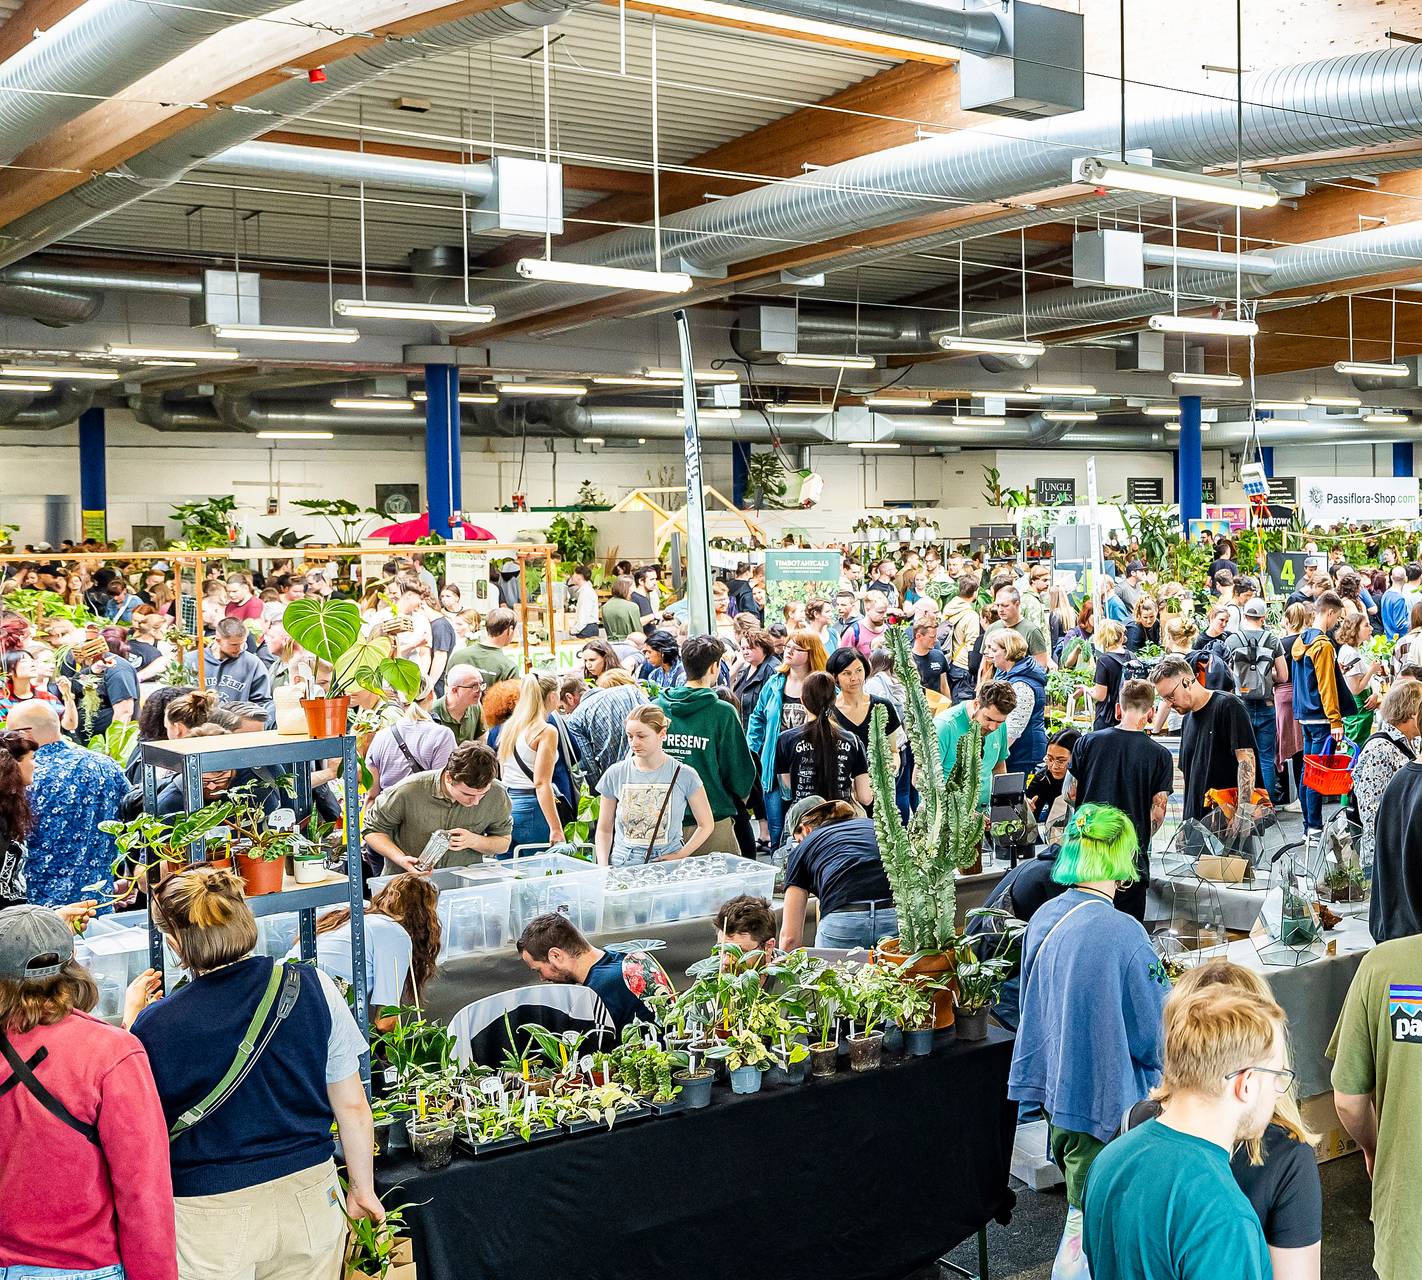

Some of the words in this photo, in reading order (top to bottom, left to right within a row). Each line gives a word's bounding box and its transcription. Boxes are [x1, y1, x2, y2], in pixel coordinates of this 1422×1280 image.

[1040, 481, 1072, 494] JUNGLE
[1045, 492, 1073, 502] LEAES
[1326, 492, 1416, 506] Passiflora-Shop.com
[774, 559, 830, 568] TIMBOTANICALS
[1280, 559, 1296, 586] 4
